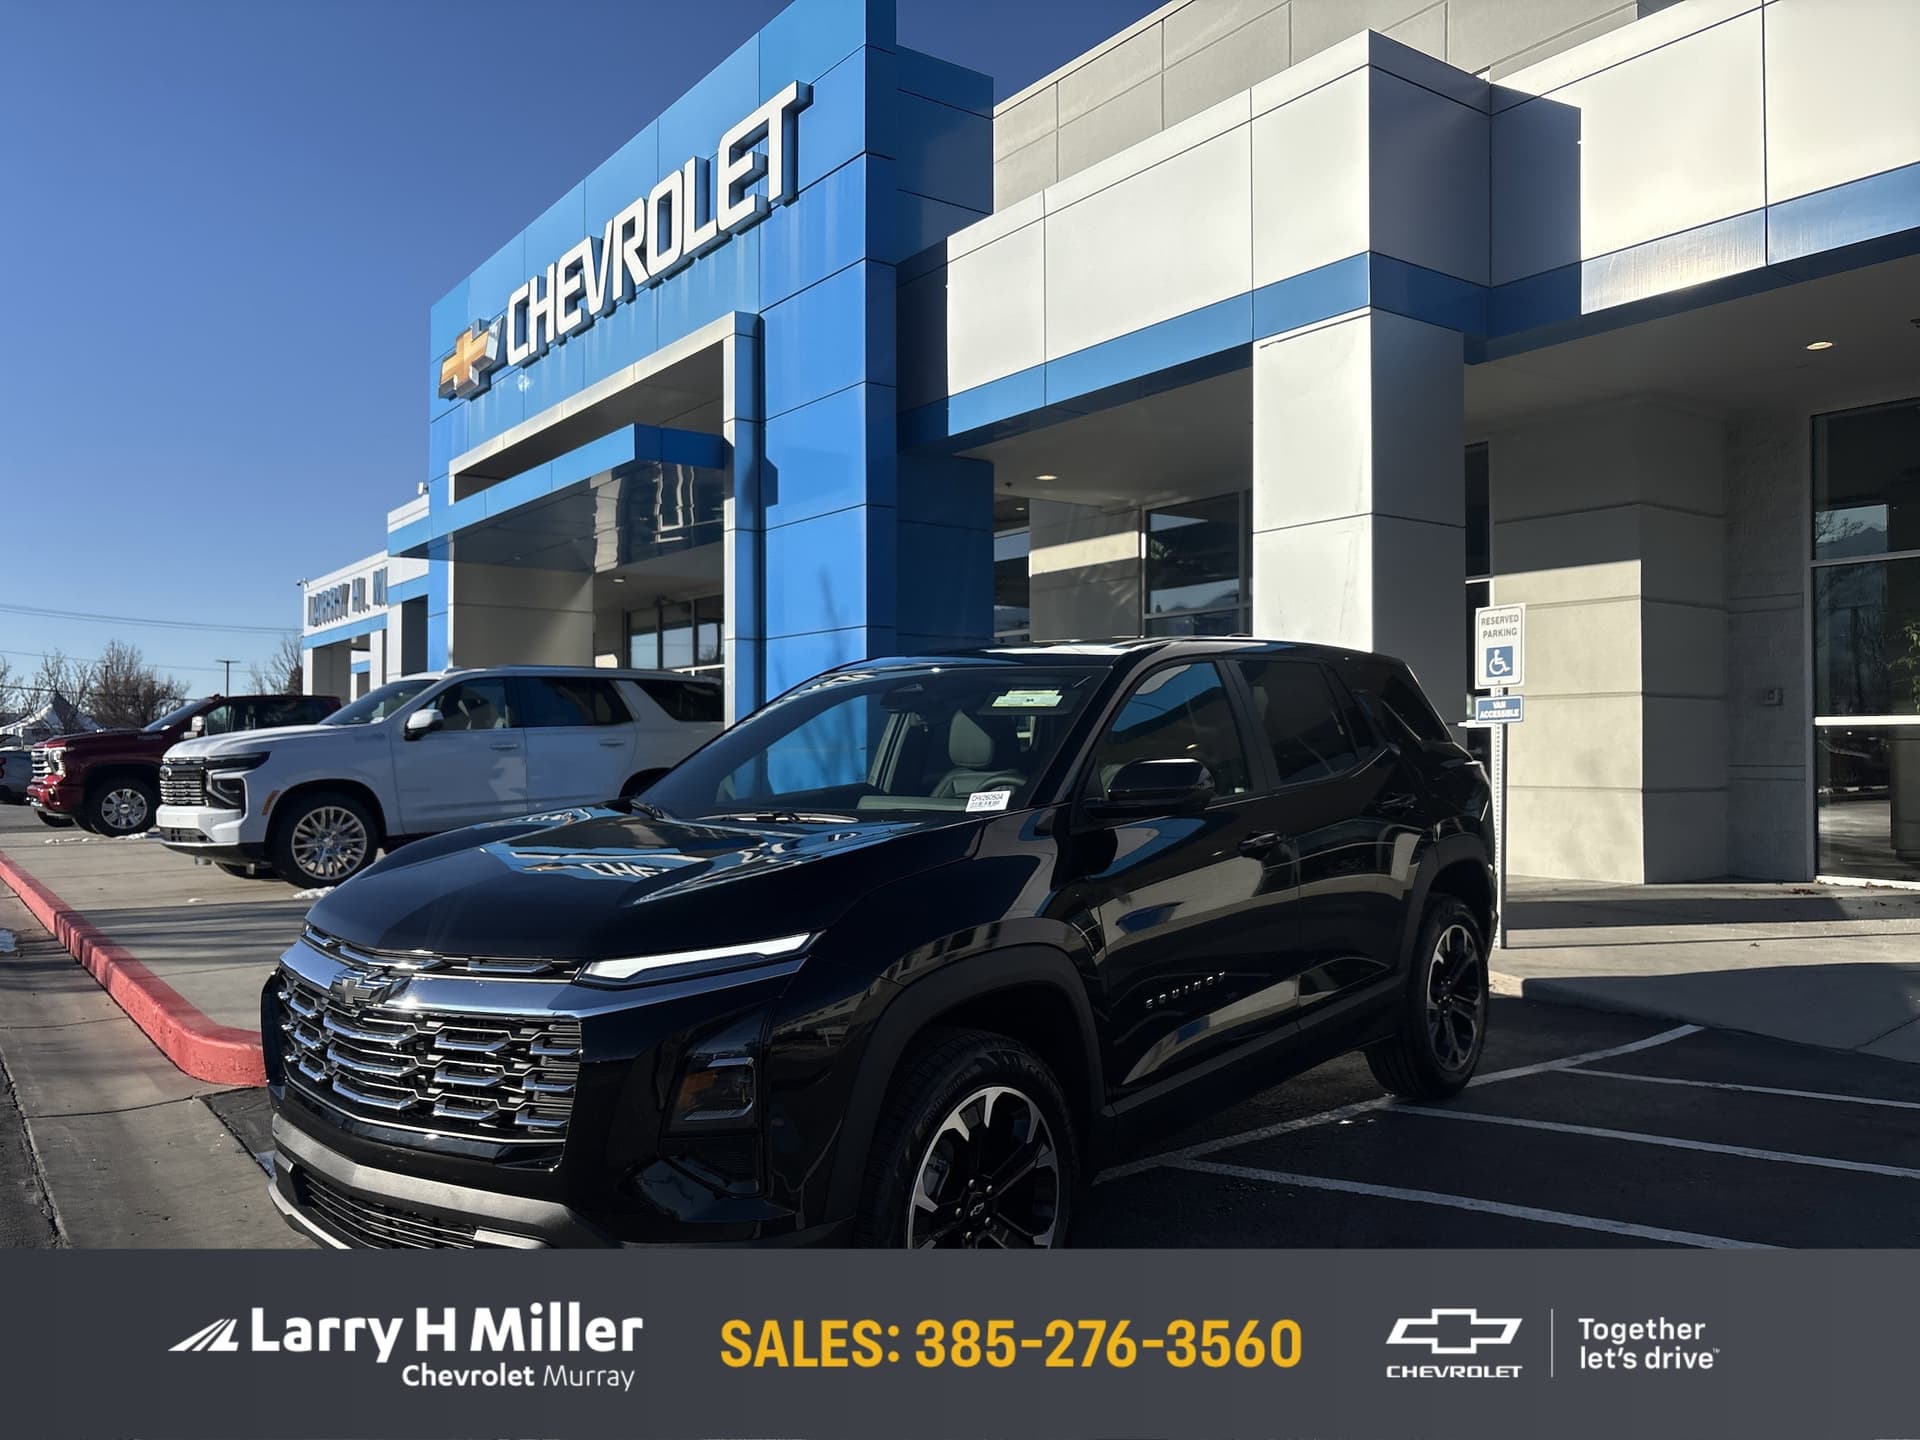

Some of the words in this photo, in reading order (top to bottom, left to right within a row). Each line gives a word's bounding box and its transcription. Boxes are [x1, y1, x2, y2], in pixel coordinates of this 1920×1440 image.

[507, 80, 812, 366] CHEVROLET
[1481, 615, 1519, 625] RESERVED
[1482, 628, 1517, 639] PARKING
[1480, 708, 1520, 719] ACCESSIBLE
[1146, 972, 1225, 1008] EQUINOX
